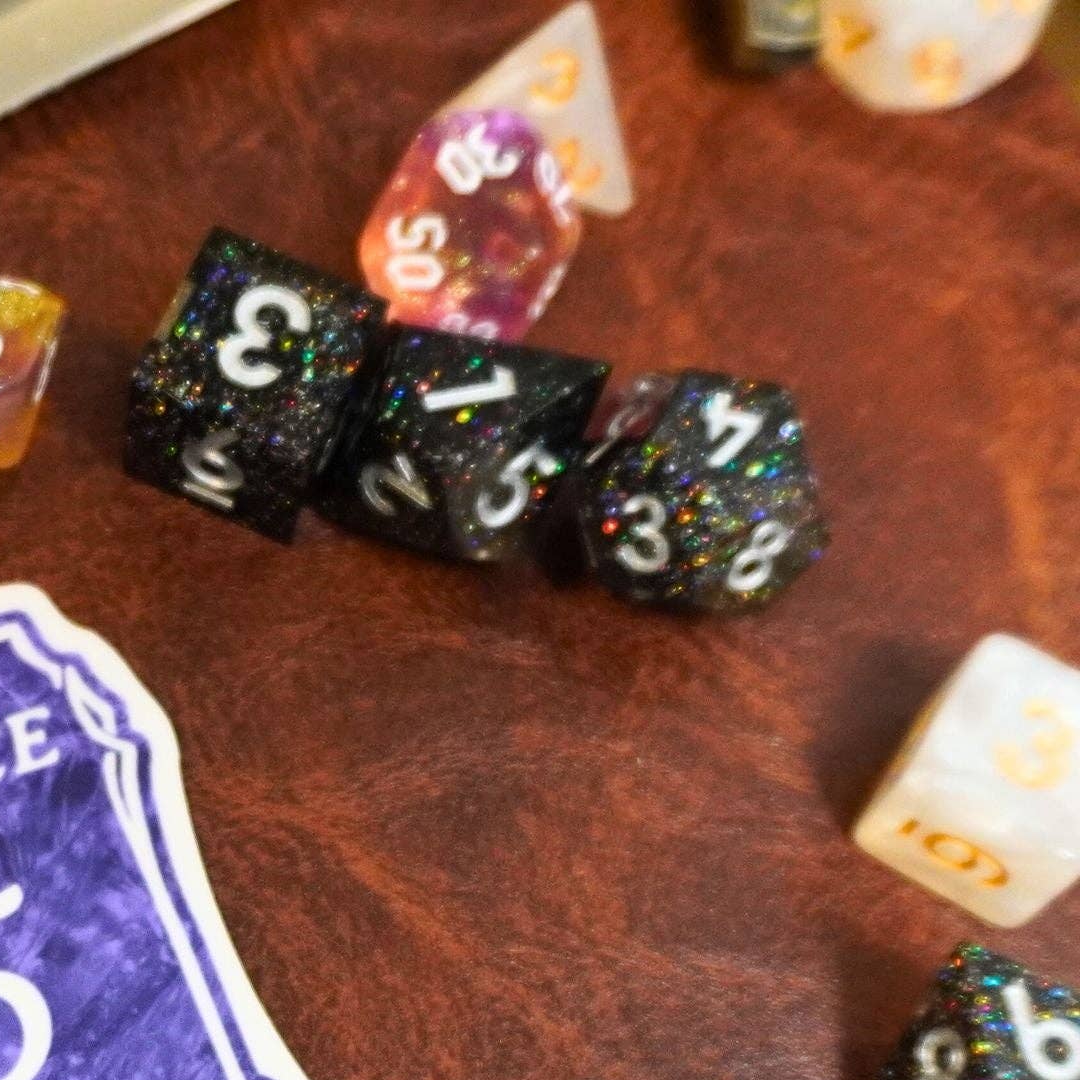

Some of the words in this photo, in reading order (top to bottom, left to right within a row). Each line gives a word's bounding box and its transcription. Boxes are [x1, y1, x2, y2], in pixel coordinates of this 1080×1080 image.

[386, 213, 448, 291] 50
[219, 284, 311, 389] 3
[701, 392, 763, 468] 4
[477, 442, 559, 528] 5
[618, 494, 668, 573] 3
[728, 520, 788, 591] 8
[992, 697, 1073, 789] 3
